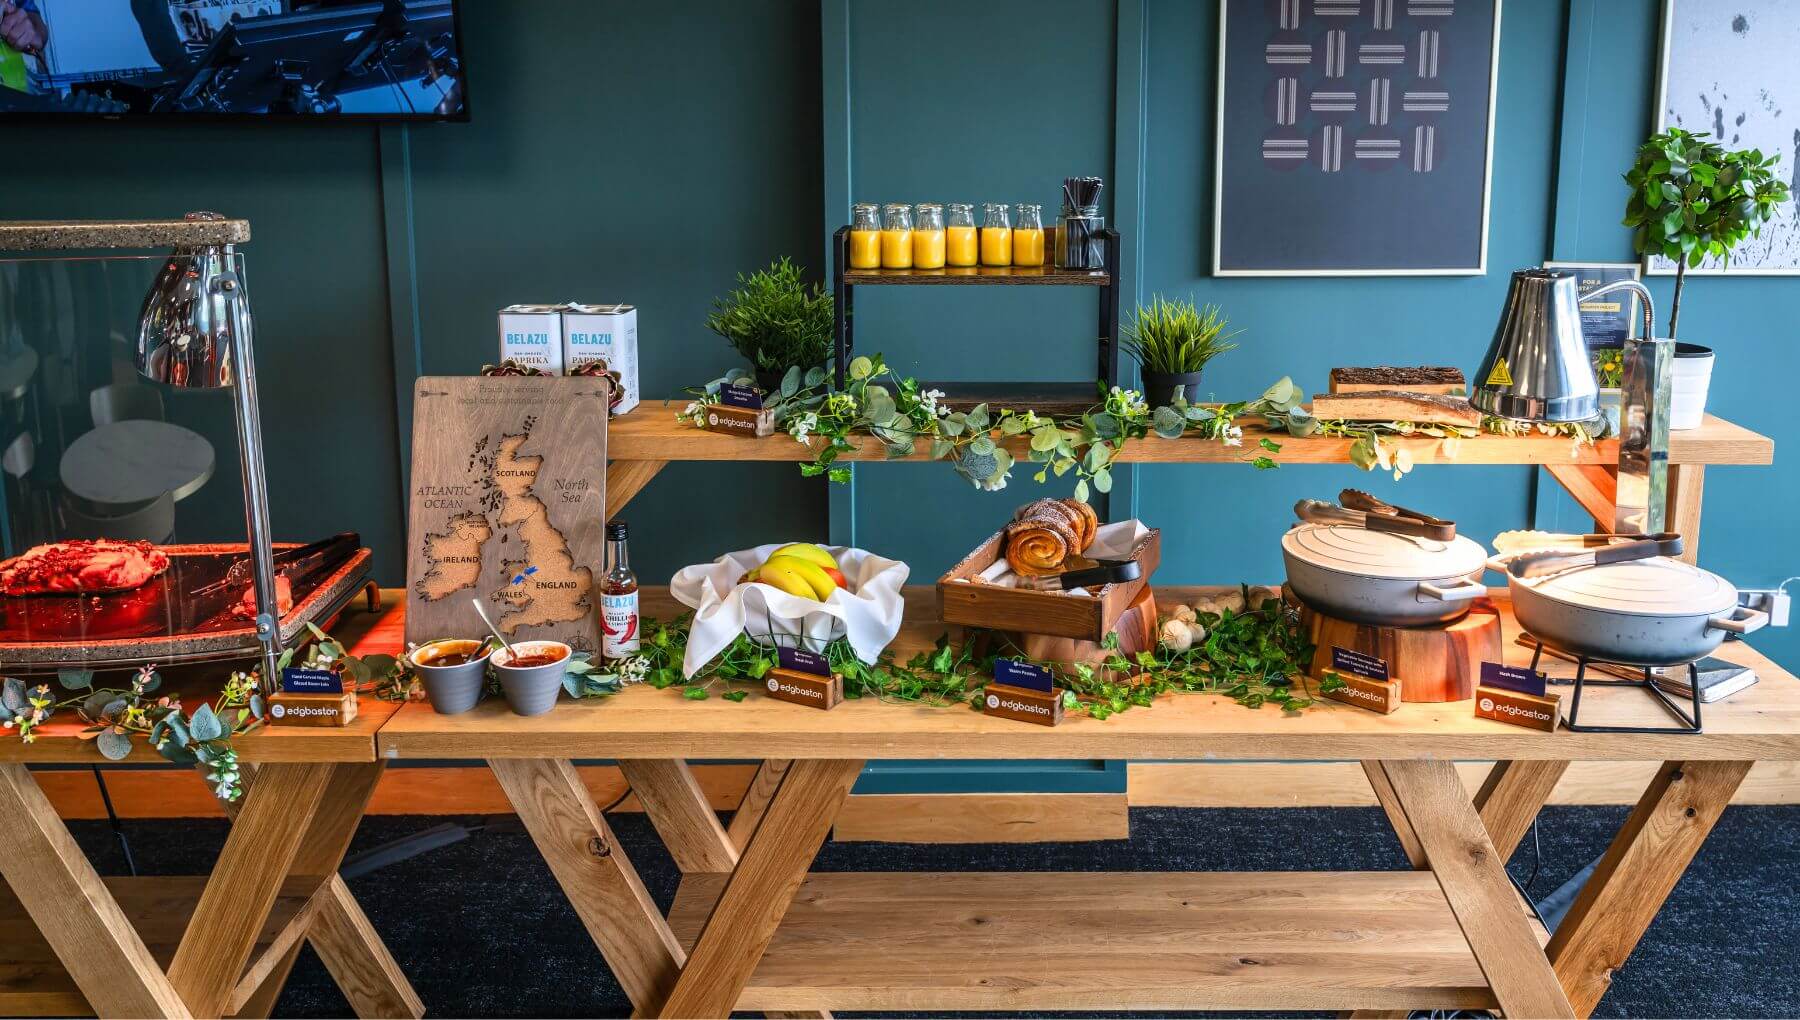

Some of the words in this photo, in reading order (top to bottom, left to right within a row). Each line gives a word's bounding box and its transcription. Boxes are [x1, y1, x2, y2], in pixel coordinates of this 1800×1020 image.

[507, 333, 548, 345] BELAZU
[572, 333, 612, 345] BELAZU
[720, 418, 755, 428] edgbaston
[554, 479, 589, 490] North
[417, 487, 471, 496] ATLANTIC
[562, 492, 581, 503] Sea
[424, 500, 463, 509] OCEAN
[780, 684, 823, 699] edgbaston
[287, 706, 338, 717] edgbaston
[1001, 700, 1050, 715] edgbaston
[1495, 704, 1550, 720] edgbaston
